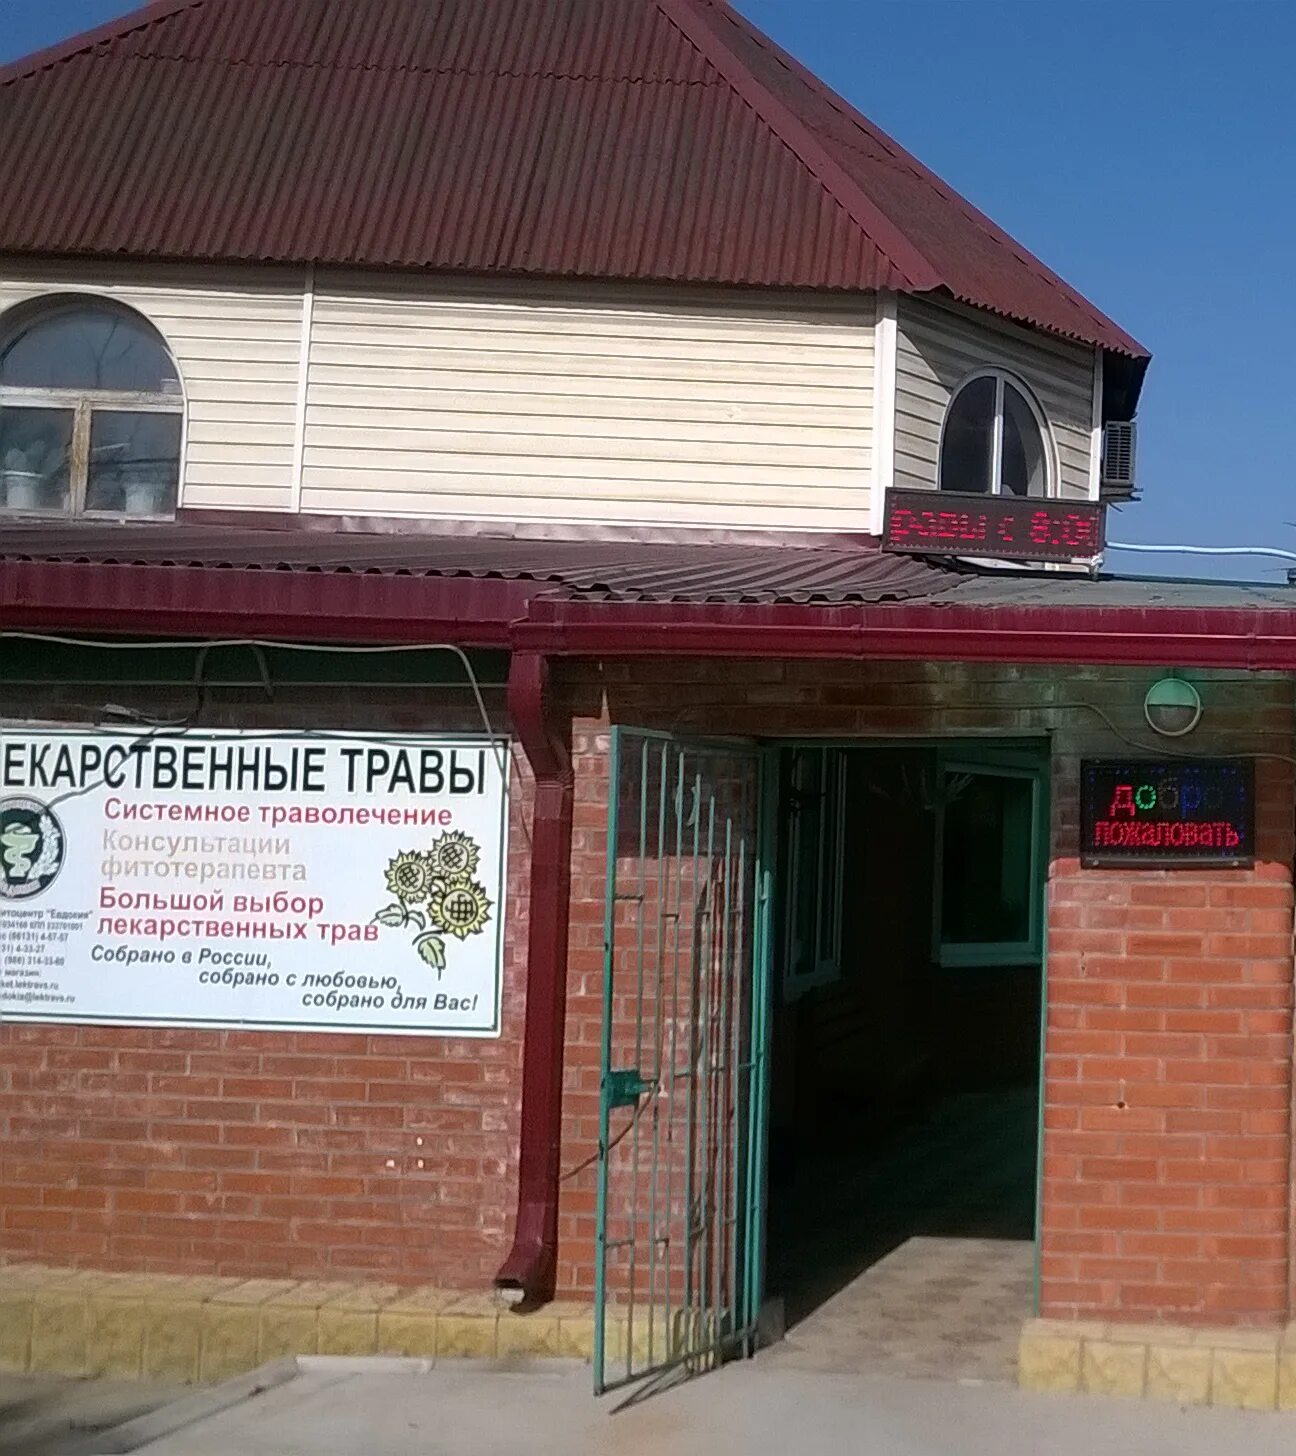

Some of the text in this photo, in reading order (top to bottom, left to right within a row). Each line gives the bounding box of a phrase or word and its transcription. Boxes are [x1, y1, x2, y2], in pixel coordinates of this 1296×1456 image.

[340, 748, 485, 795] ТРАВЫ
[104, 798, 452, 827] Системное траволечение
[102, 829, 290, 855] Консультации
[100, 856, 307, 882] фитотерапевта
[100, 886, 324, 918] Большой выбор
[97, 914, 379, 941] лекарственных трав
[91, 944, 272, 968] Собрано в России,
[199, 967, 402, 993] собрано с любовью,
[302, 988, 478, 1012] собрано для Вас!
